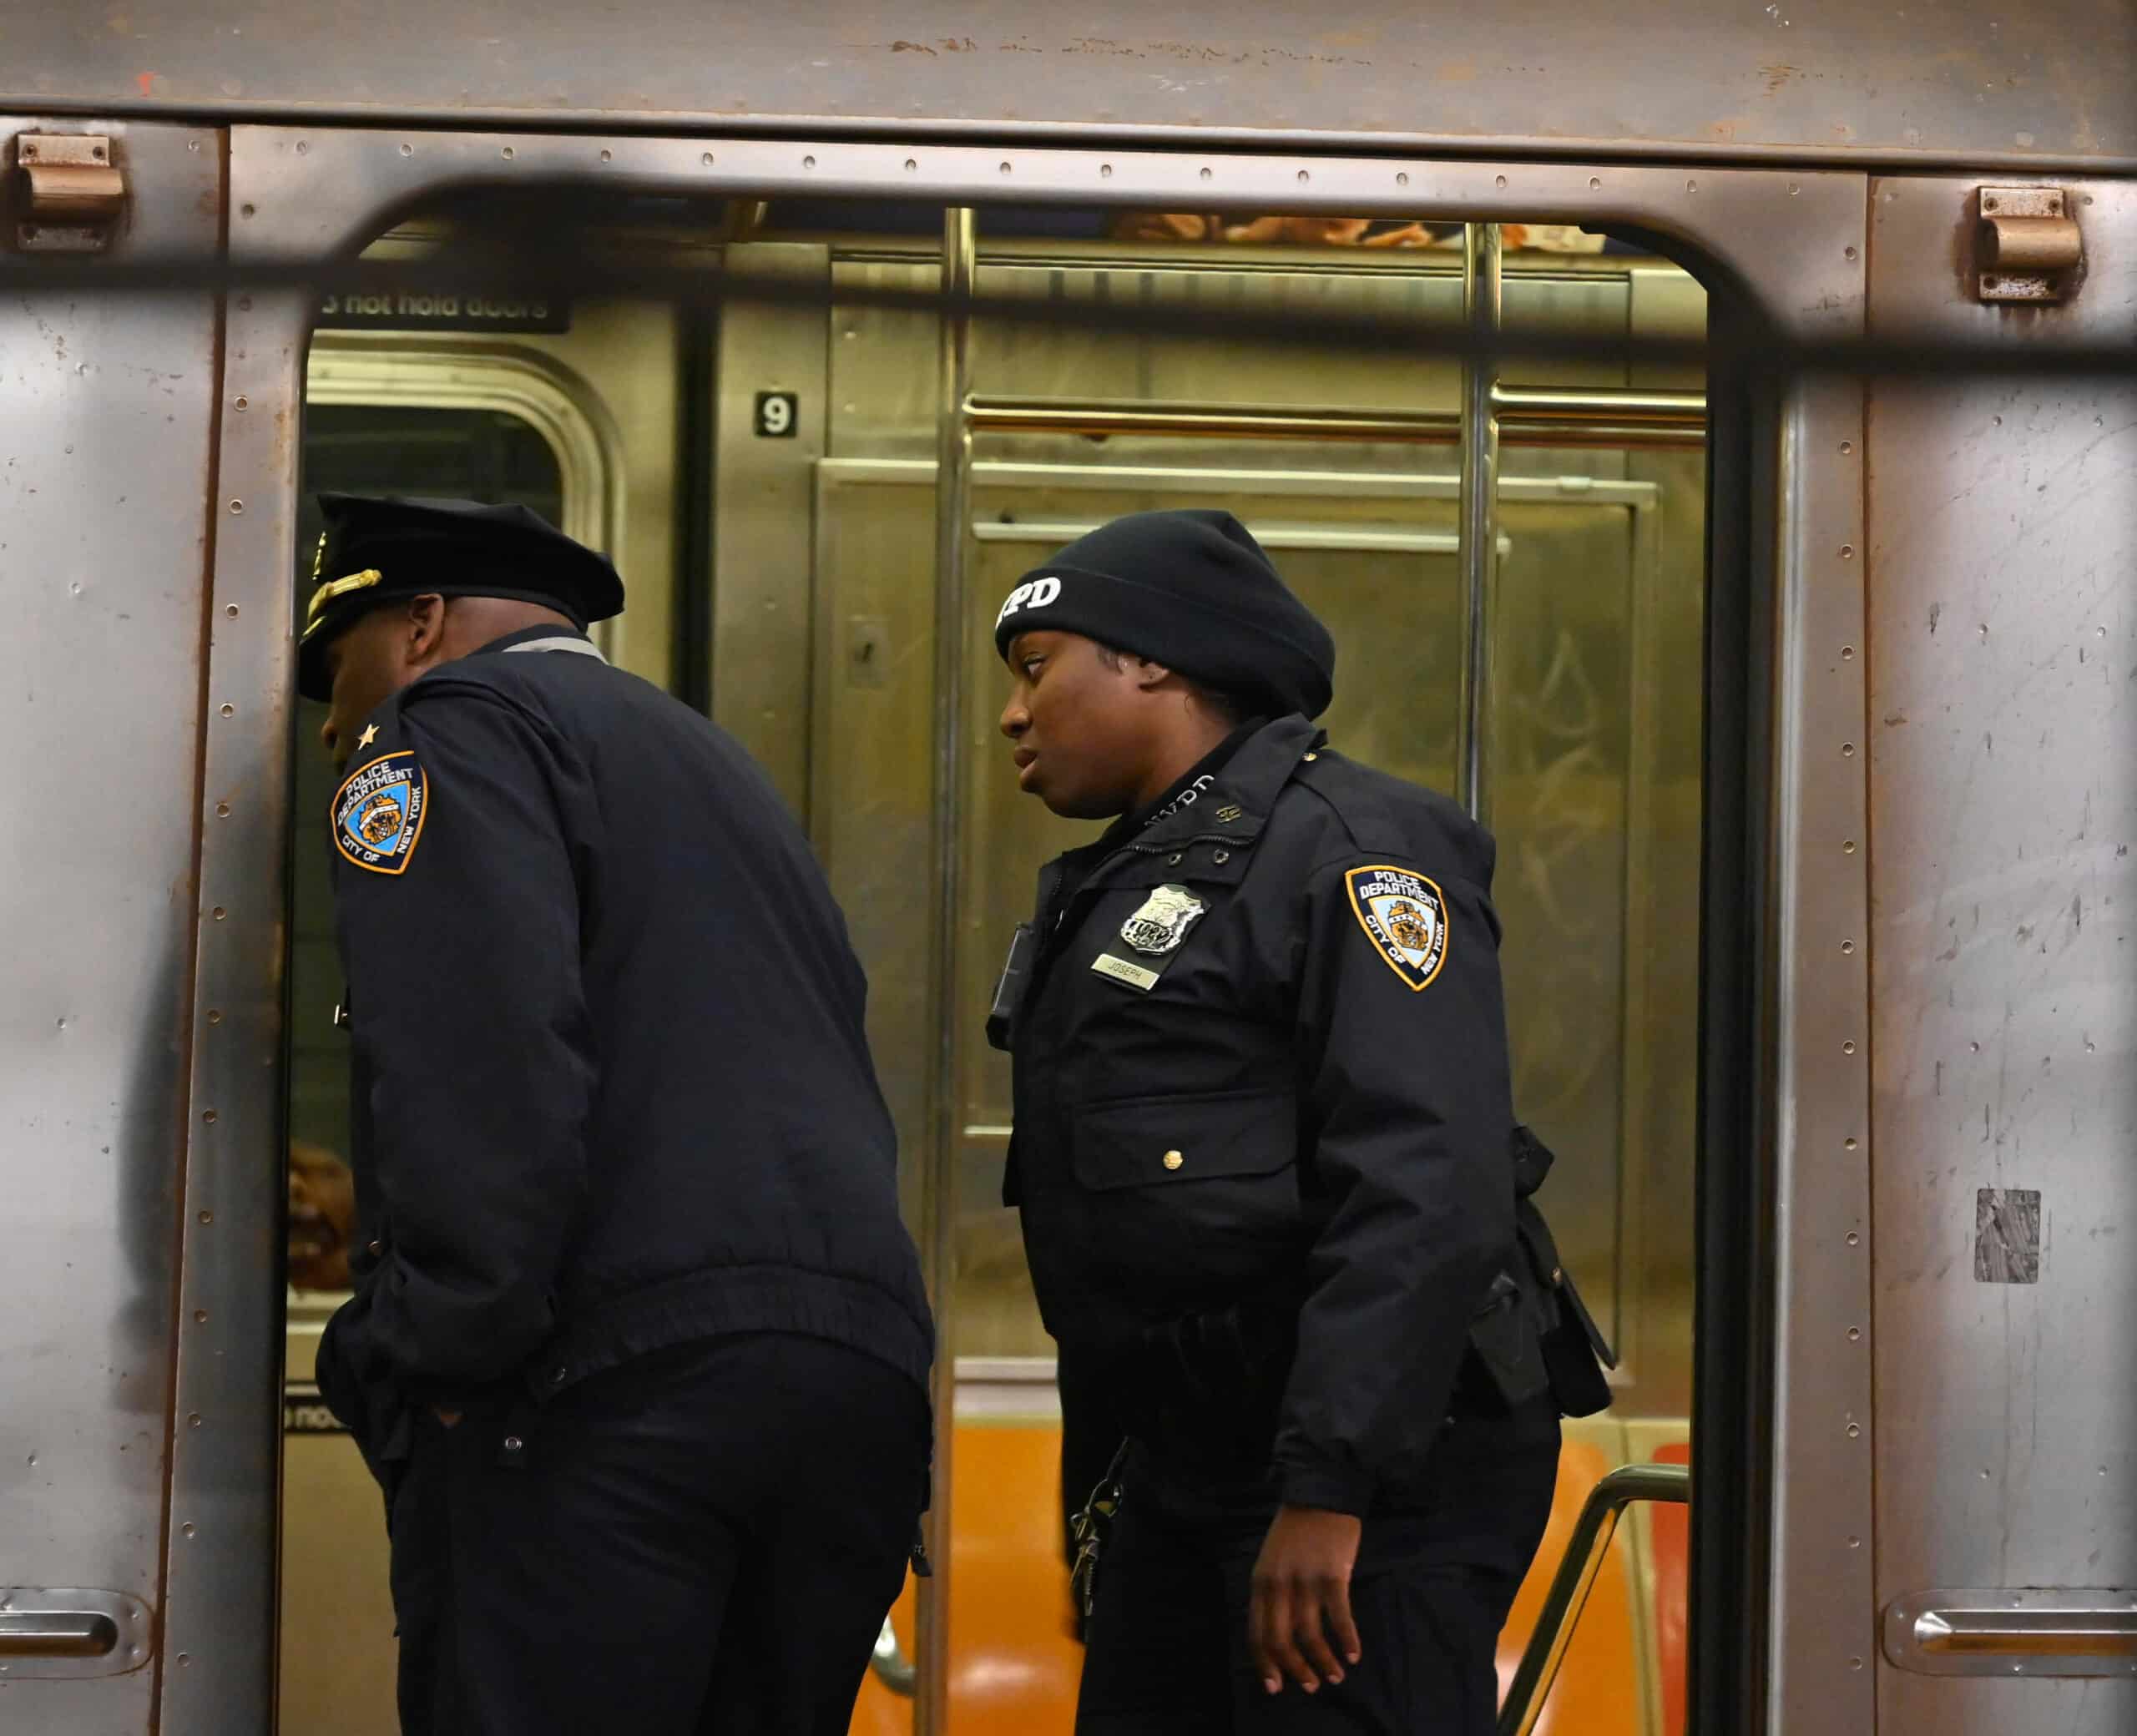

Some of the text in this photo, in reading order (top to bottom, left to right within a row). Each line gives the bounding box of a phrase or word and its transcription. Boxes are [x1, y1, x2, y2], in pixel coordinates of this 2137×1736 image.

[763, 396, 791, 433] 9
[337, 768, 415, 827] DEPARTMENT
[346, 761, 391, 798] POLICE
[341, 785, 422, 863] CITY OF NEW YORK
[1359, 881, 1439, 911] DEPARTMENT
[1374, 871, 1422, 891] POLICE
[1366, 914, 1390, 944] CITY
[1387, 946, 1406, 965] OF
[1108, 961, 1144, 981] JOSEPH
